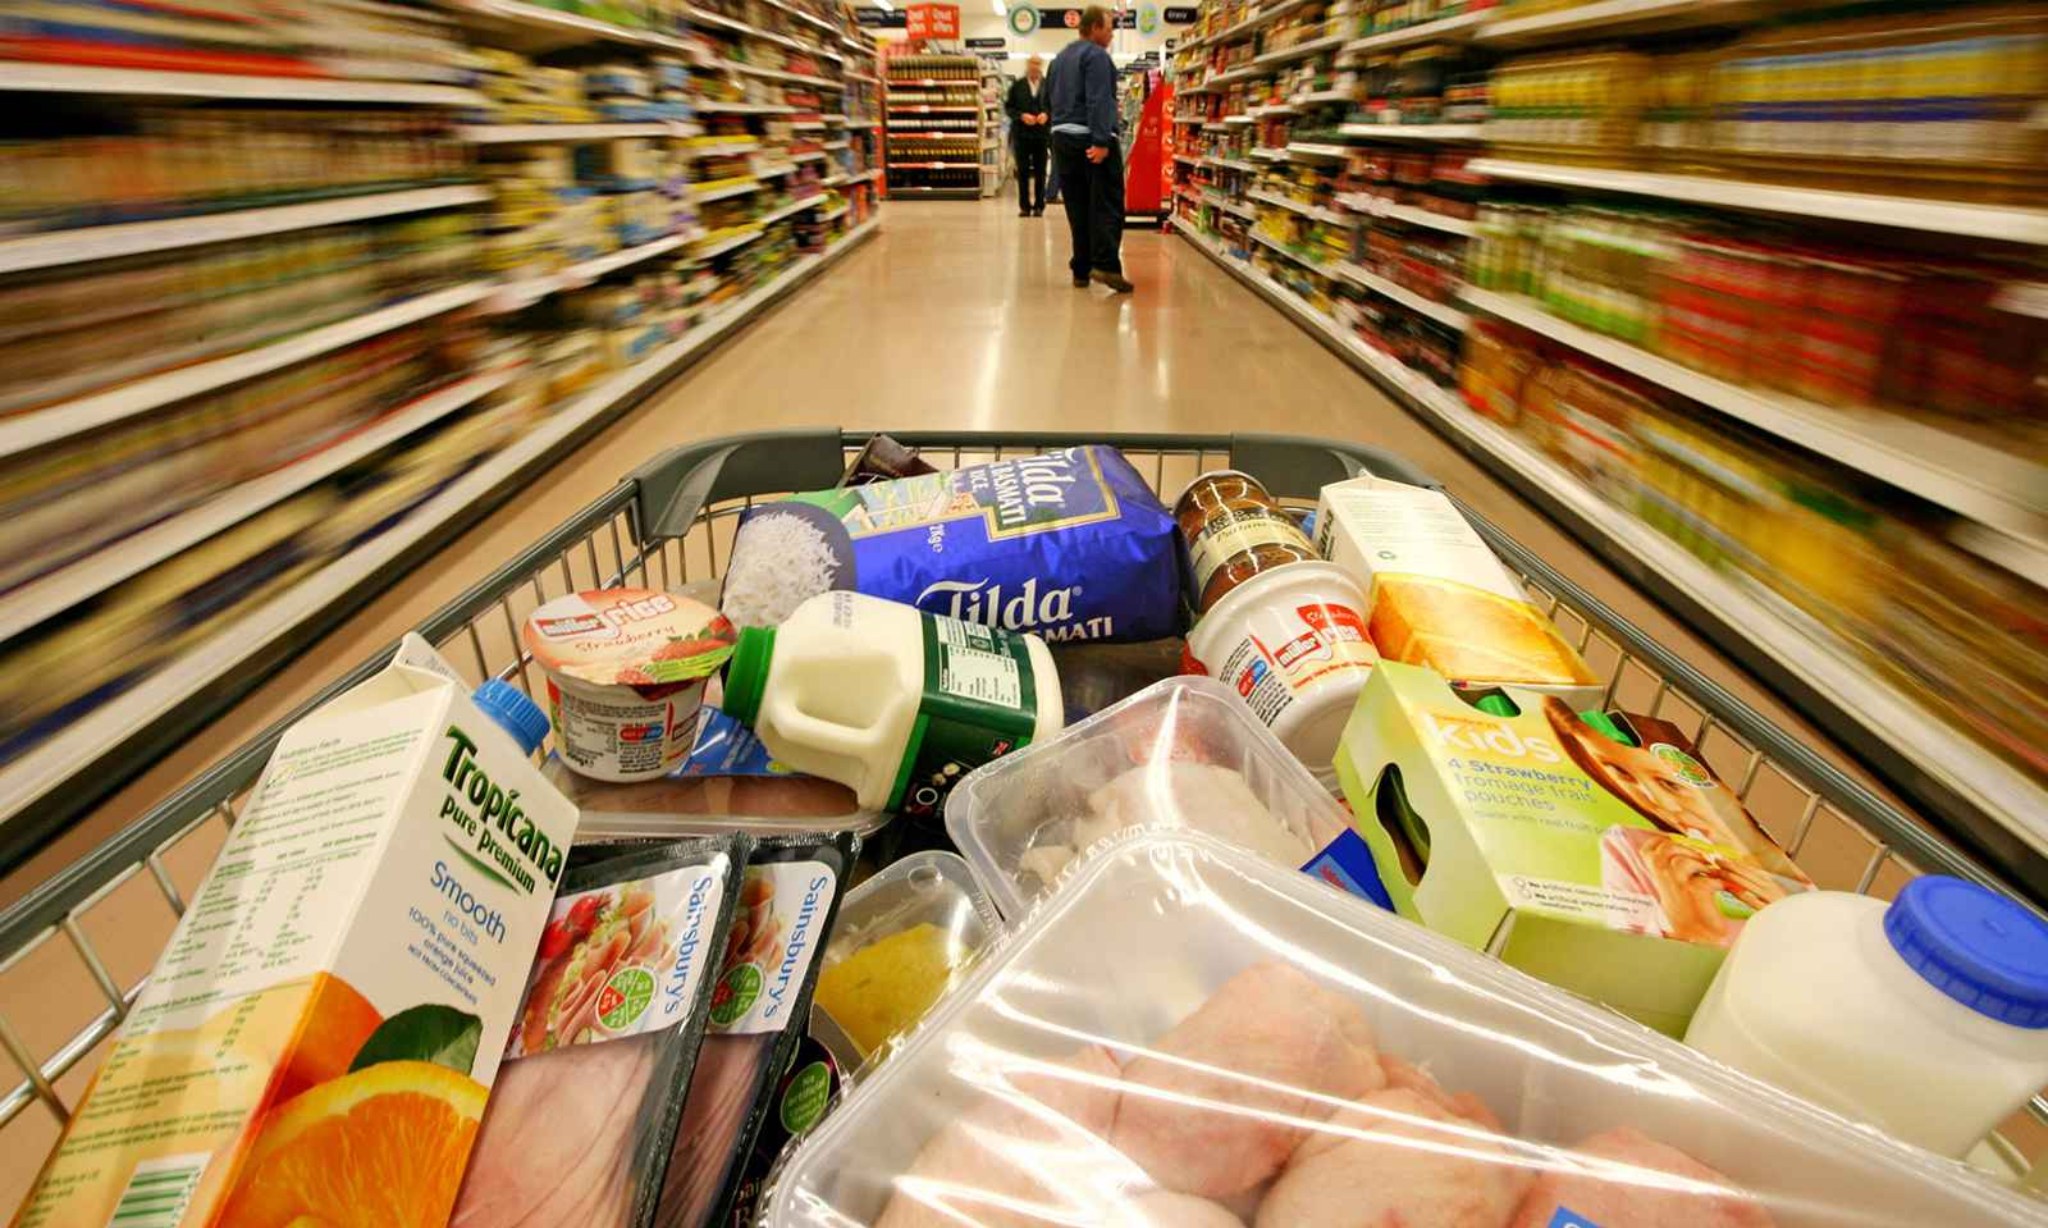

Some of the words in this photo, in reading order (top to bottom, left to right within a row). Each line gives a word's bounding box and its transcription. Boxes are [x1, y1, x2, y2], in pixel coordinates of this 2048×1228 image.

[916, 577, 1074, 631] Tilda
[575, 626, 676, 652] Strawberry
[1422, 711, 1560, 763] kids
[1455, 773, 1545, 796] fromage
[1551, 784, 1598, 804] frais
[1468, 759, 1592, 790] Strawberry
[442, 724, 563, 885] Tropicana
[1463, 790, 1556, 811] pouches
[439, 794, 477, 838] pure
[477, 827, 536, 895] premium
[409, 906, 437, 937] 100%
[430, 860, 506, 944] Smooth
[443, 910, 459, 928] no
[423, 938, 454, 968] orange
[664, 876, 713, 1014] Sainsbury's
[763, 876, 828, 1018] Sainsbury's
